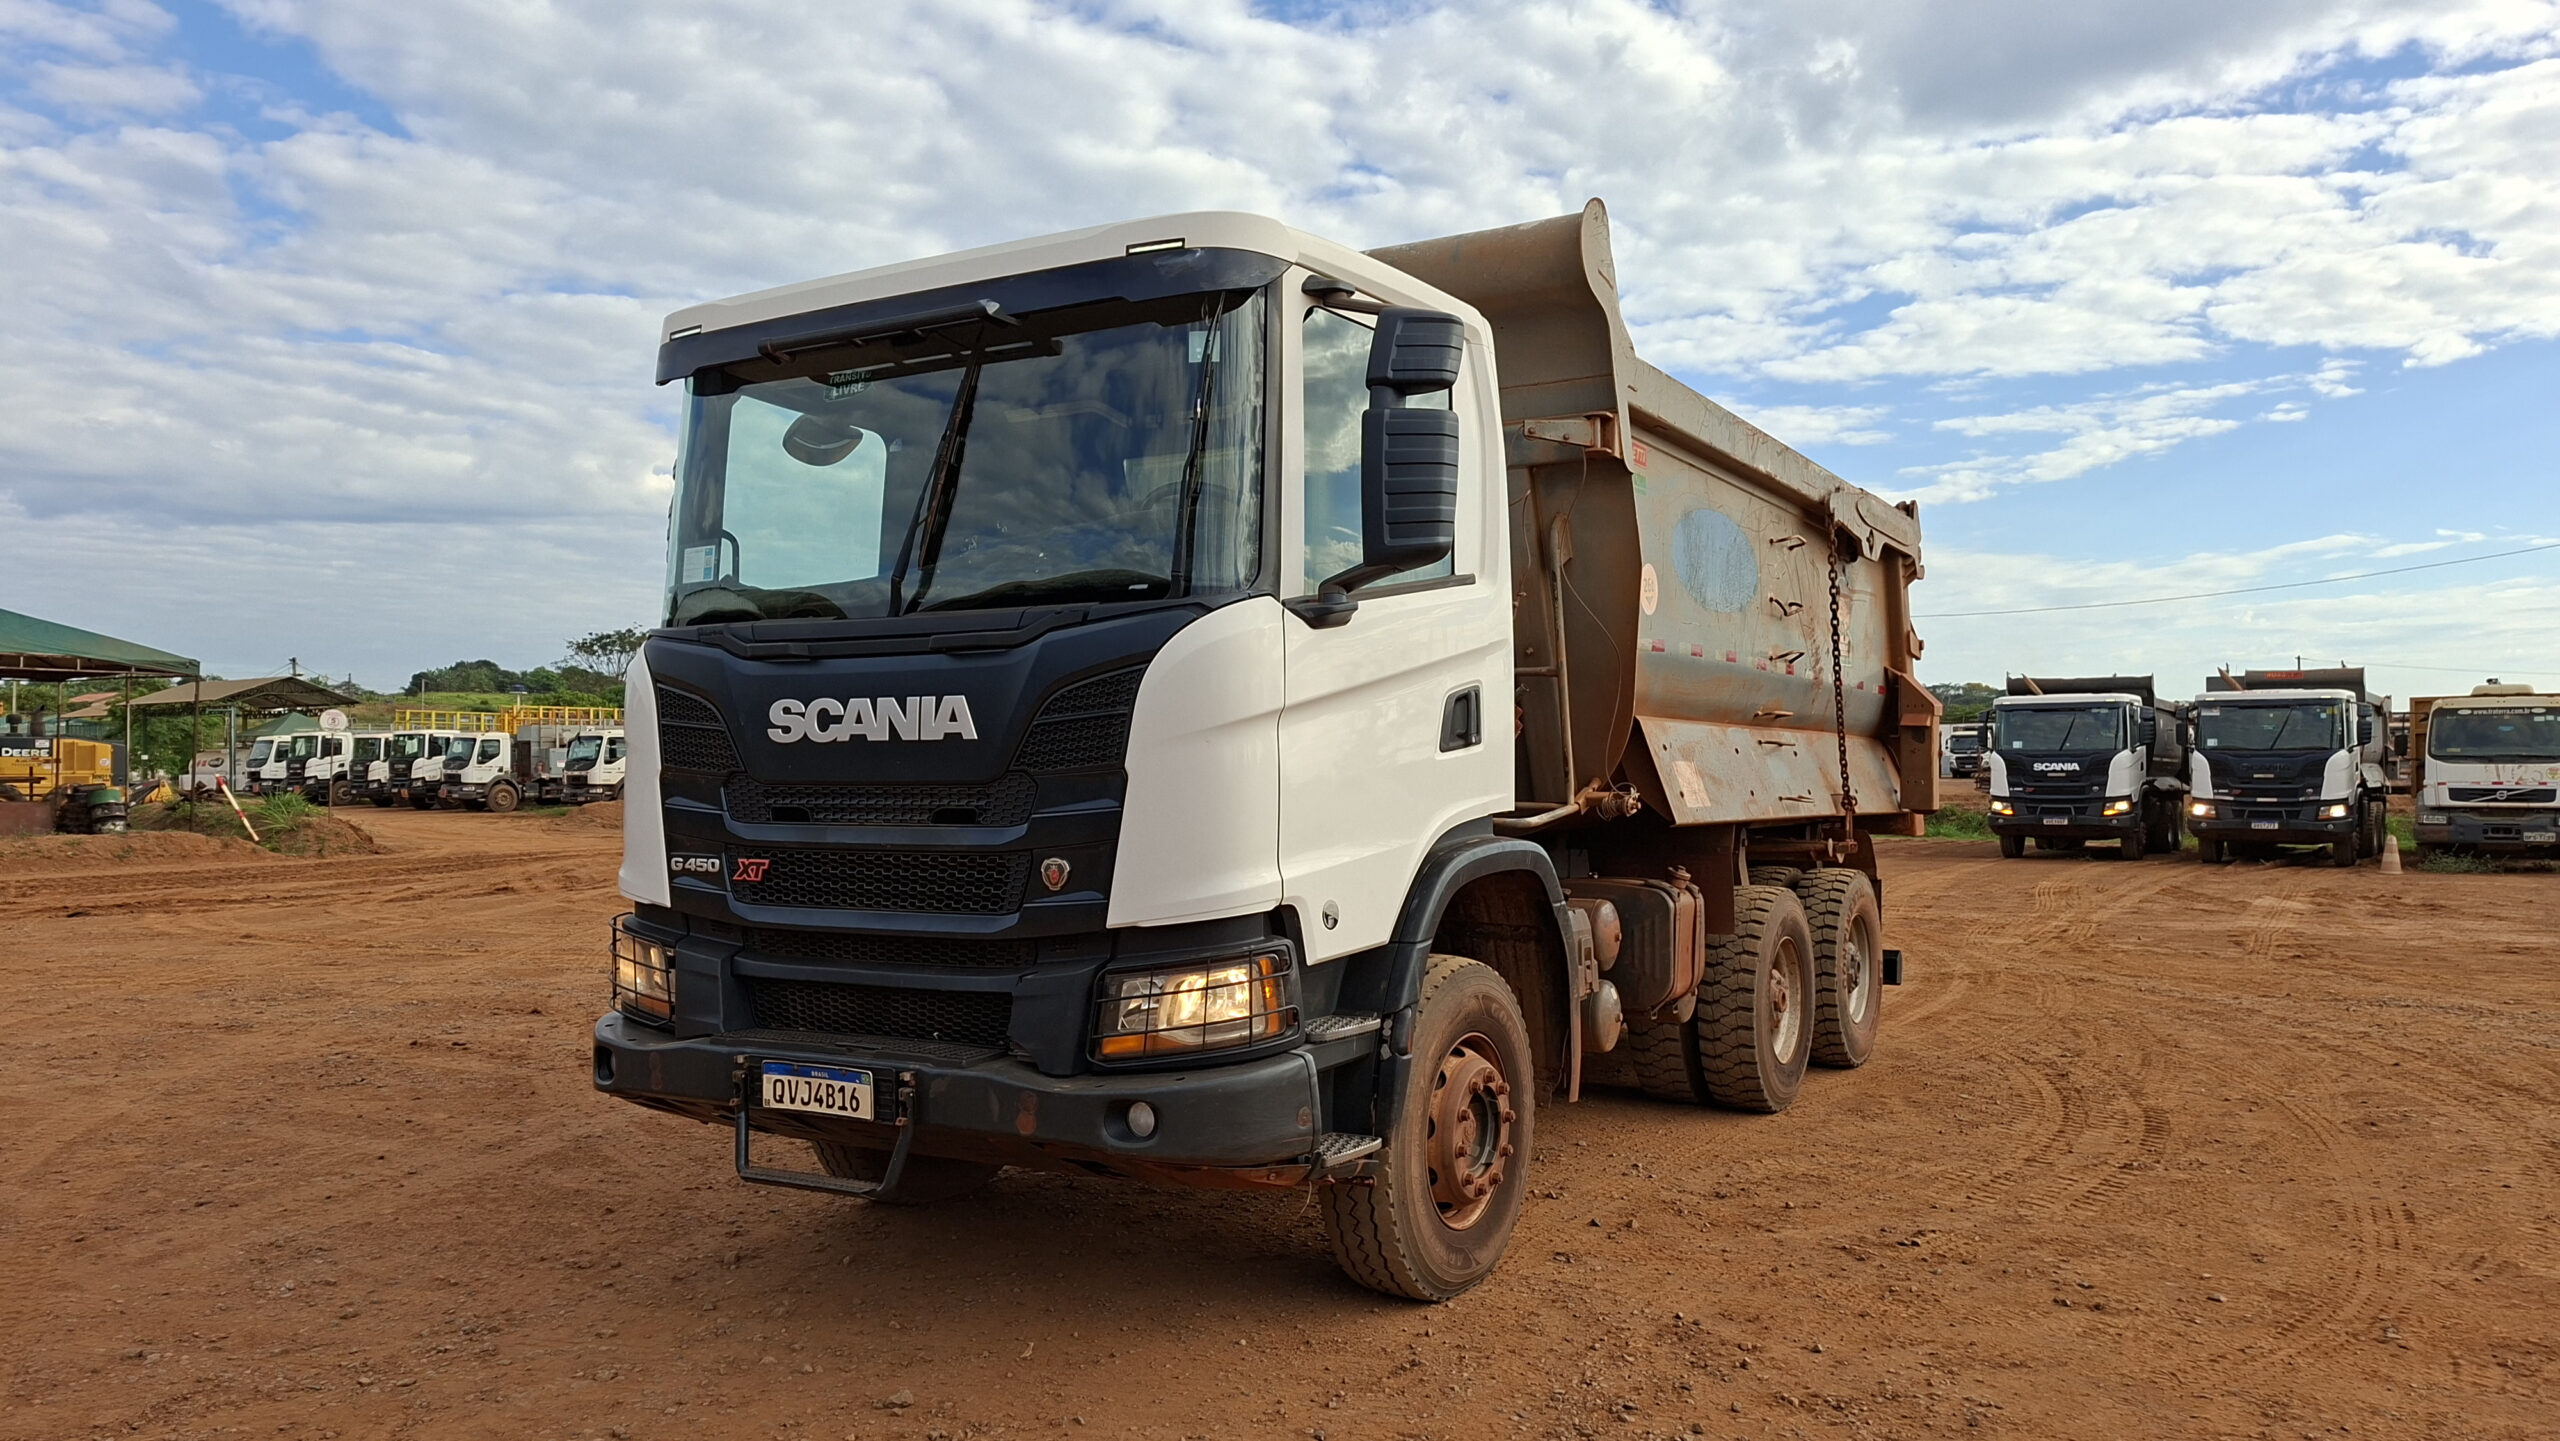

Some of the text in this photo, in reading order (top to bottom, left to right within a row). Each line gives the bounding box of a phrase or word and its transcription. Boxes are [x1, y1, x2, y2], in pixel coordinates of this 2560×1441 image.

[833, 383, 865, 396] LIVRE
[767, 695, 978, 743] SCANIA
[1, 747, 49, 757] DEERE
[2033, 762, 2080, 771] SCANIA
[732, 858, 770, 881] XT
[772, 1079, 860, 1112] QVJ4B16
